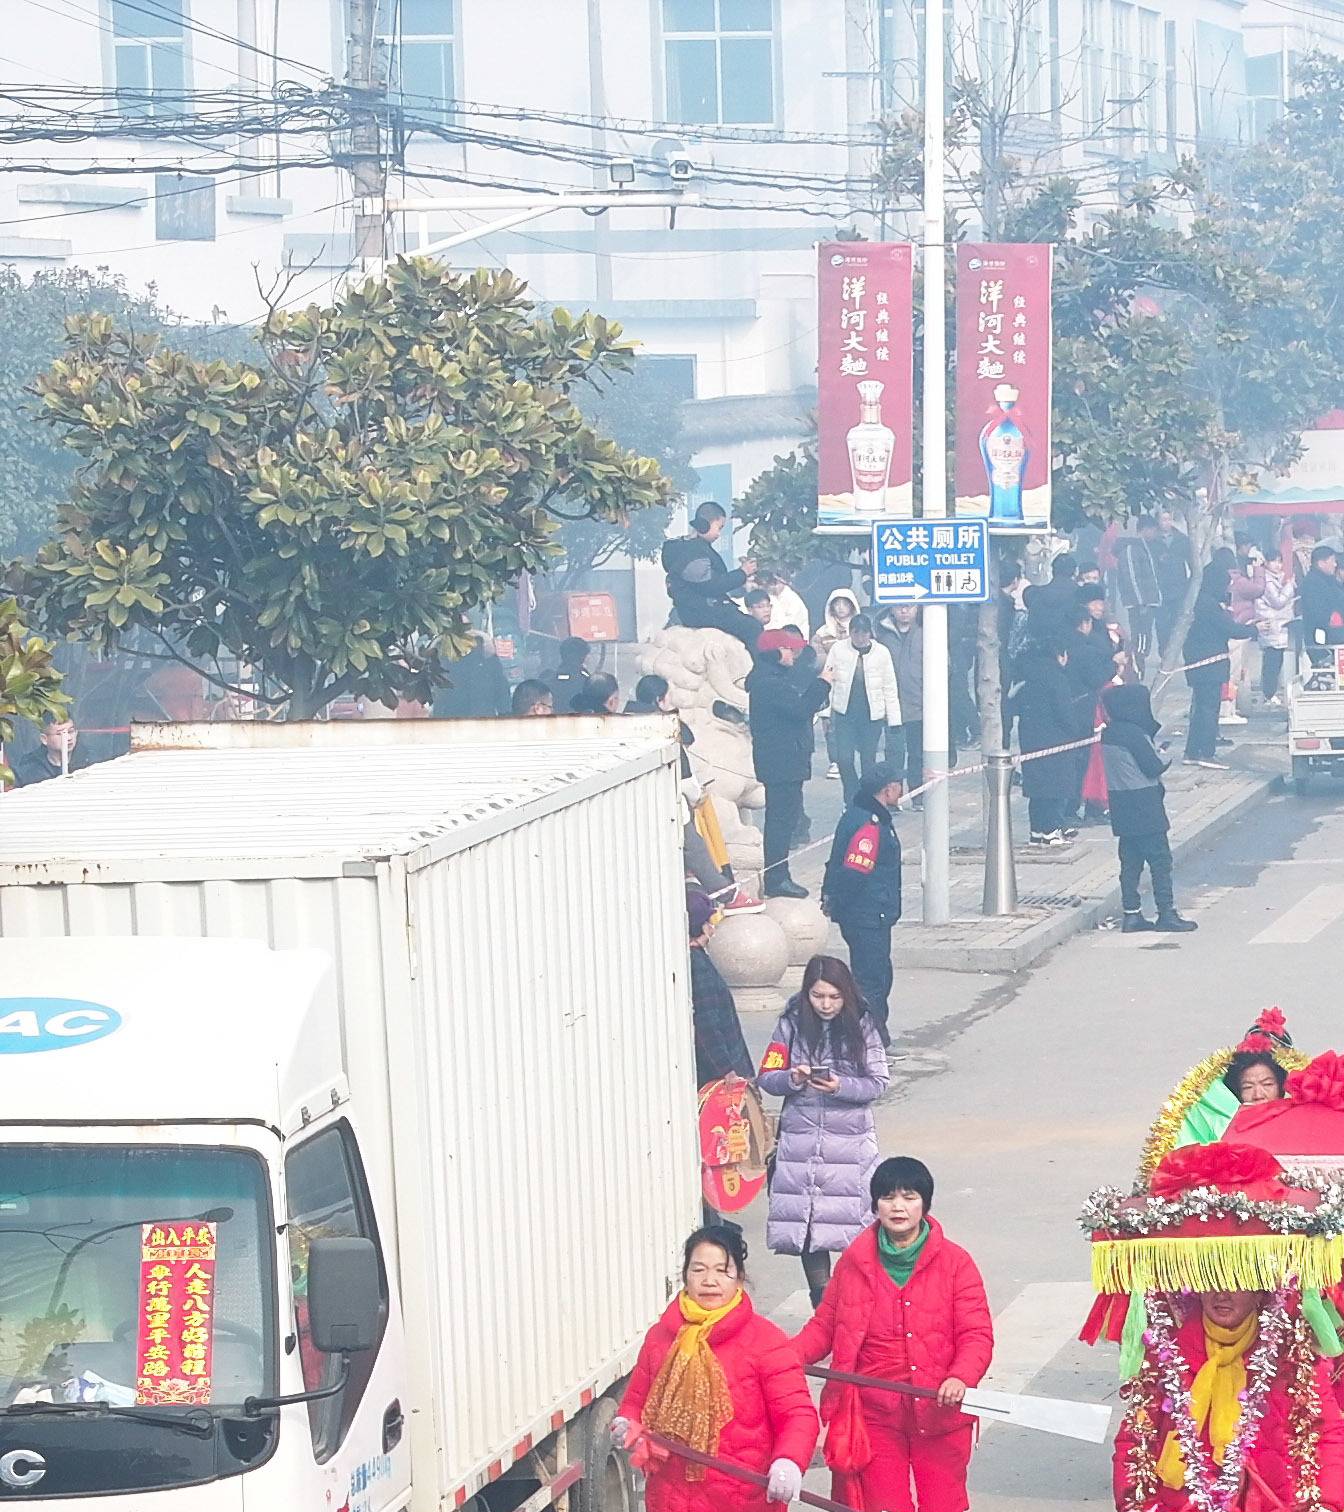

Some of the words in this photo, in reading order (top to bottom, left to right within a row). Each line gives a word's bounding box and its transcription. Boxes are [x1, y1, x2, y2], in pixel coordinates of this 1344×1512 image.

[881, 525, 980, 550] 公共厕所
[886, 554, 929, 566] PUBLIC
[935, 553, 975, 565] TOILET
[152, 1226, 212, 1246] 出入平安
